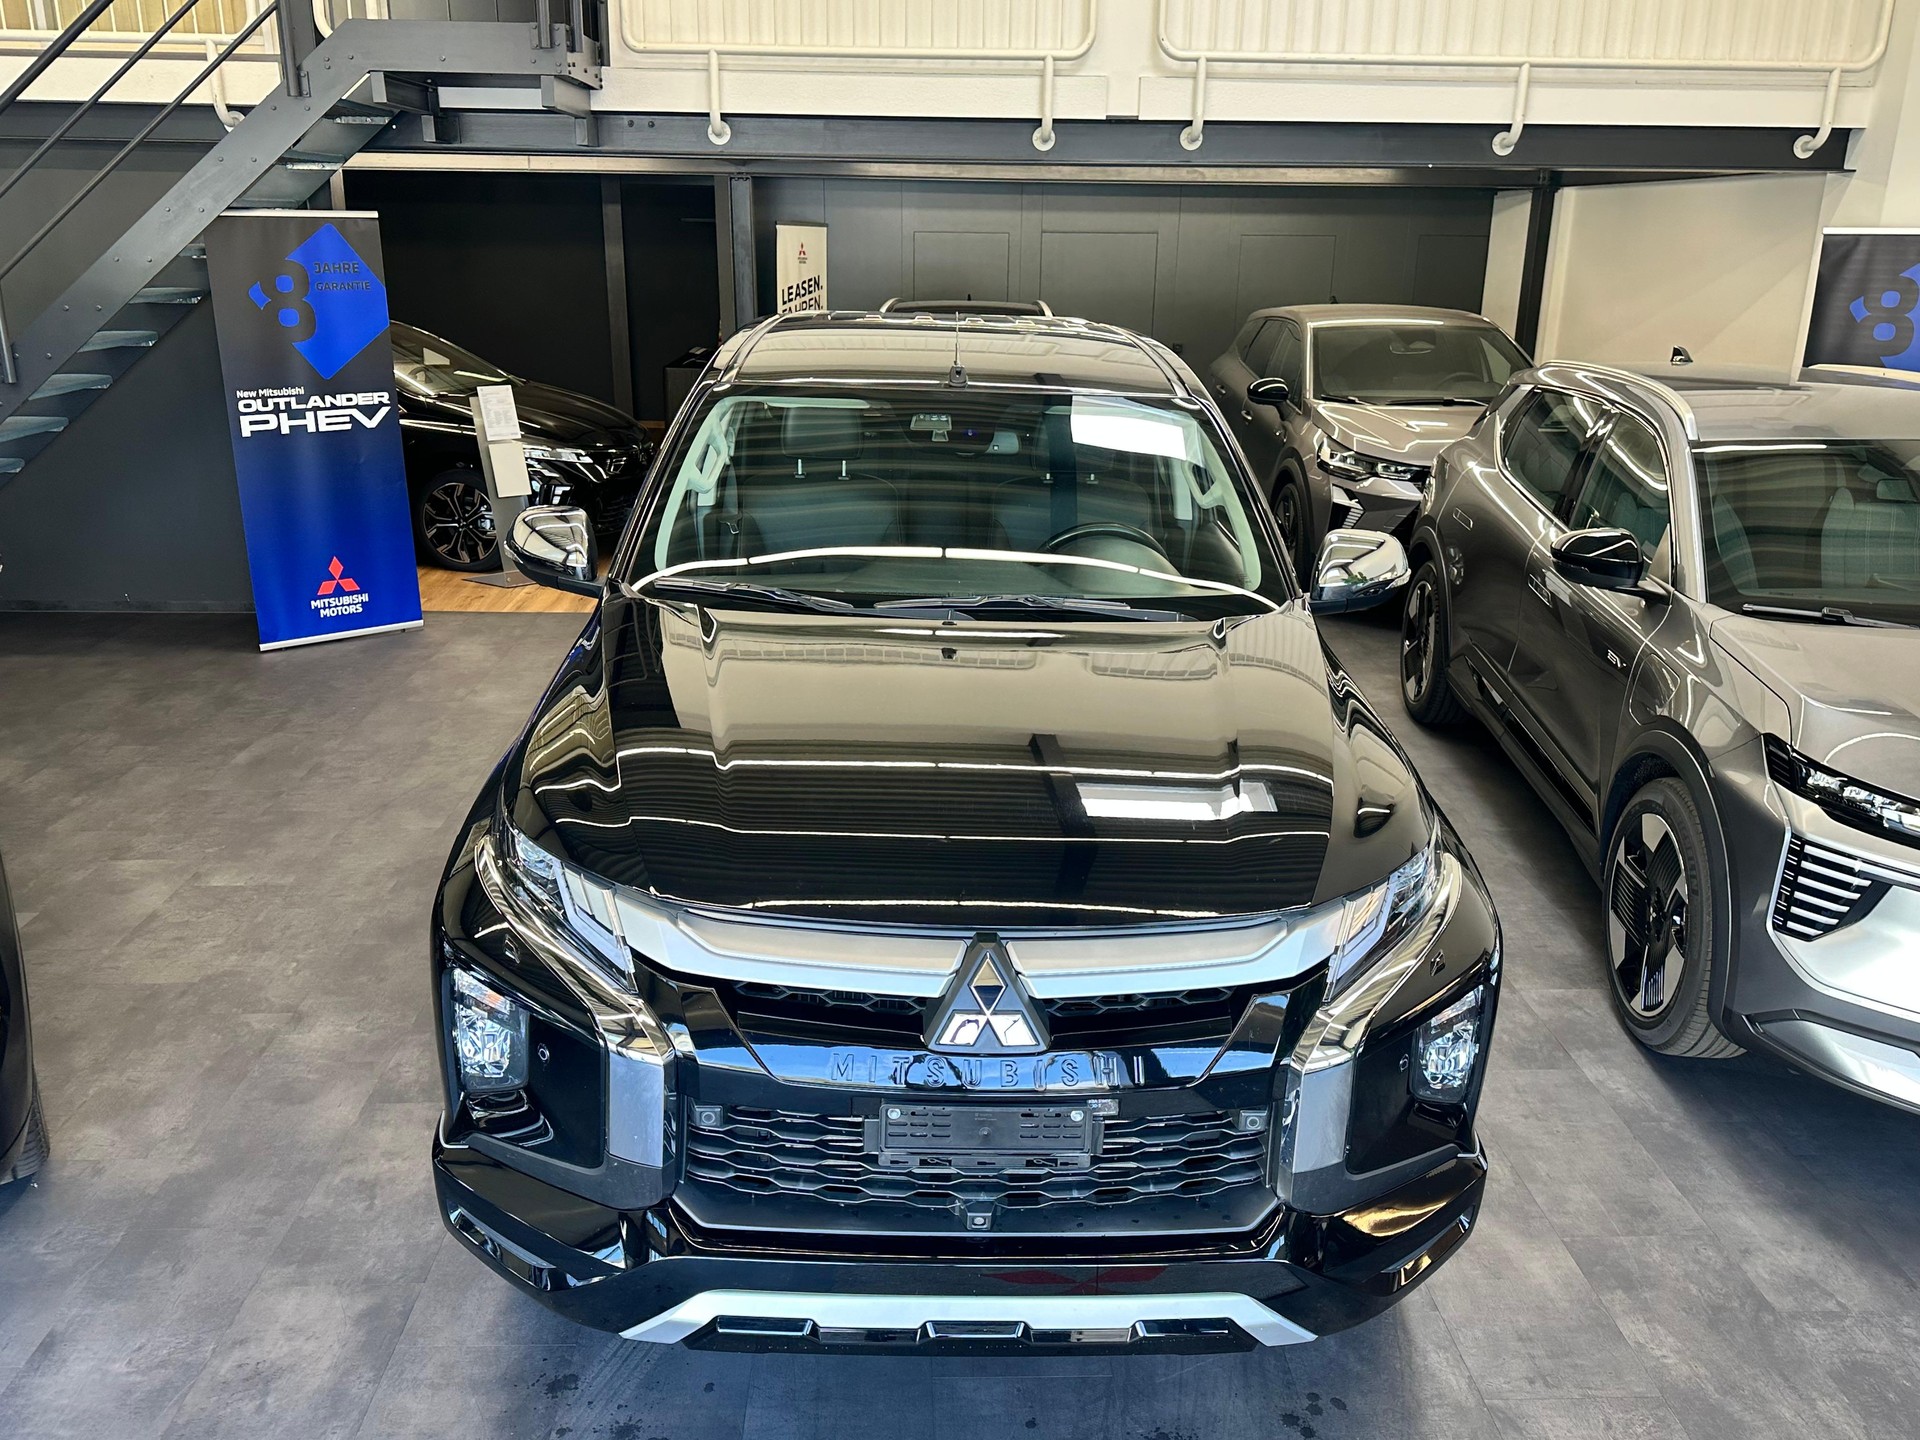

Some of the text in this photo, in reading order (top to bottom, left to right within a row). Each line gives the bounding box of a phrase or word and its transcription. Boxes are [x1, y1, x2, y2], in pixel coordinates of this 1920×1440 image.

[314, 262, 360, 274] JAHRE
[316, 280, 371, 291] GARANTIE
[781, 274, 823, 306] LEASEN.
[236, 386, 305, 399] New Mitsubishi
[237, 391, 391, 413] OUTLANDER
[239, 406, 392, 438] PHEV
[310, 593, 369, 610] MITSUBISHI
[319, 603, 363, 618] MOTORS
[830, 1052, 1146, 1090] MITSUBISHI
